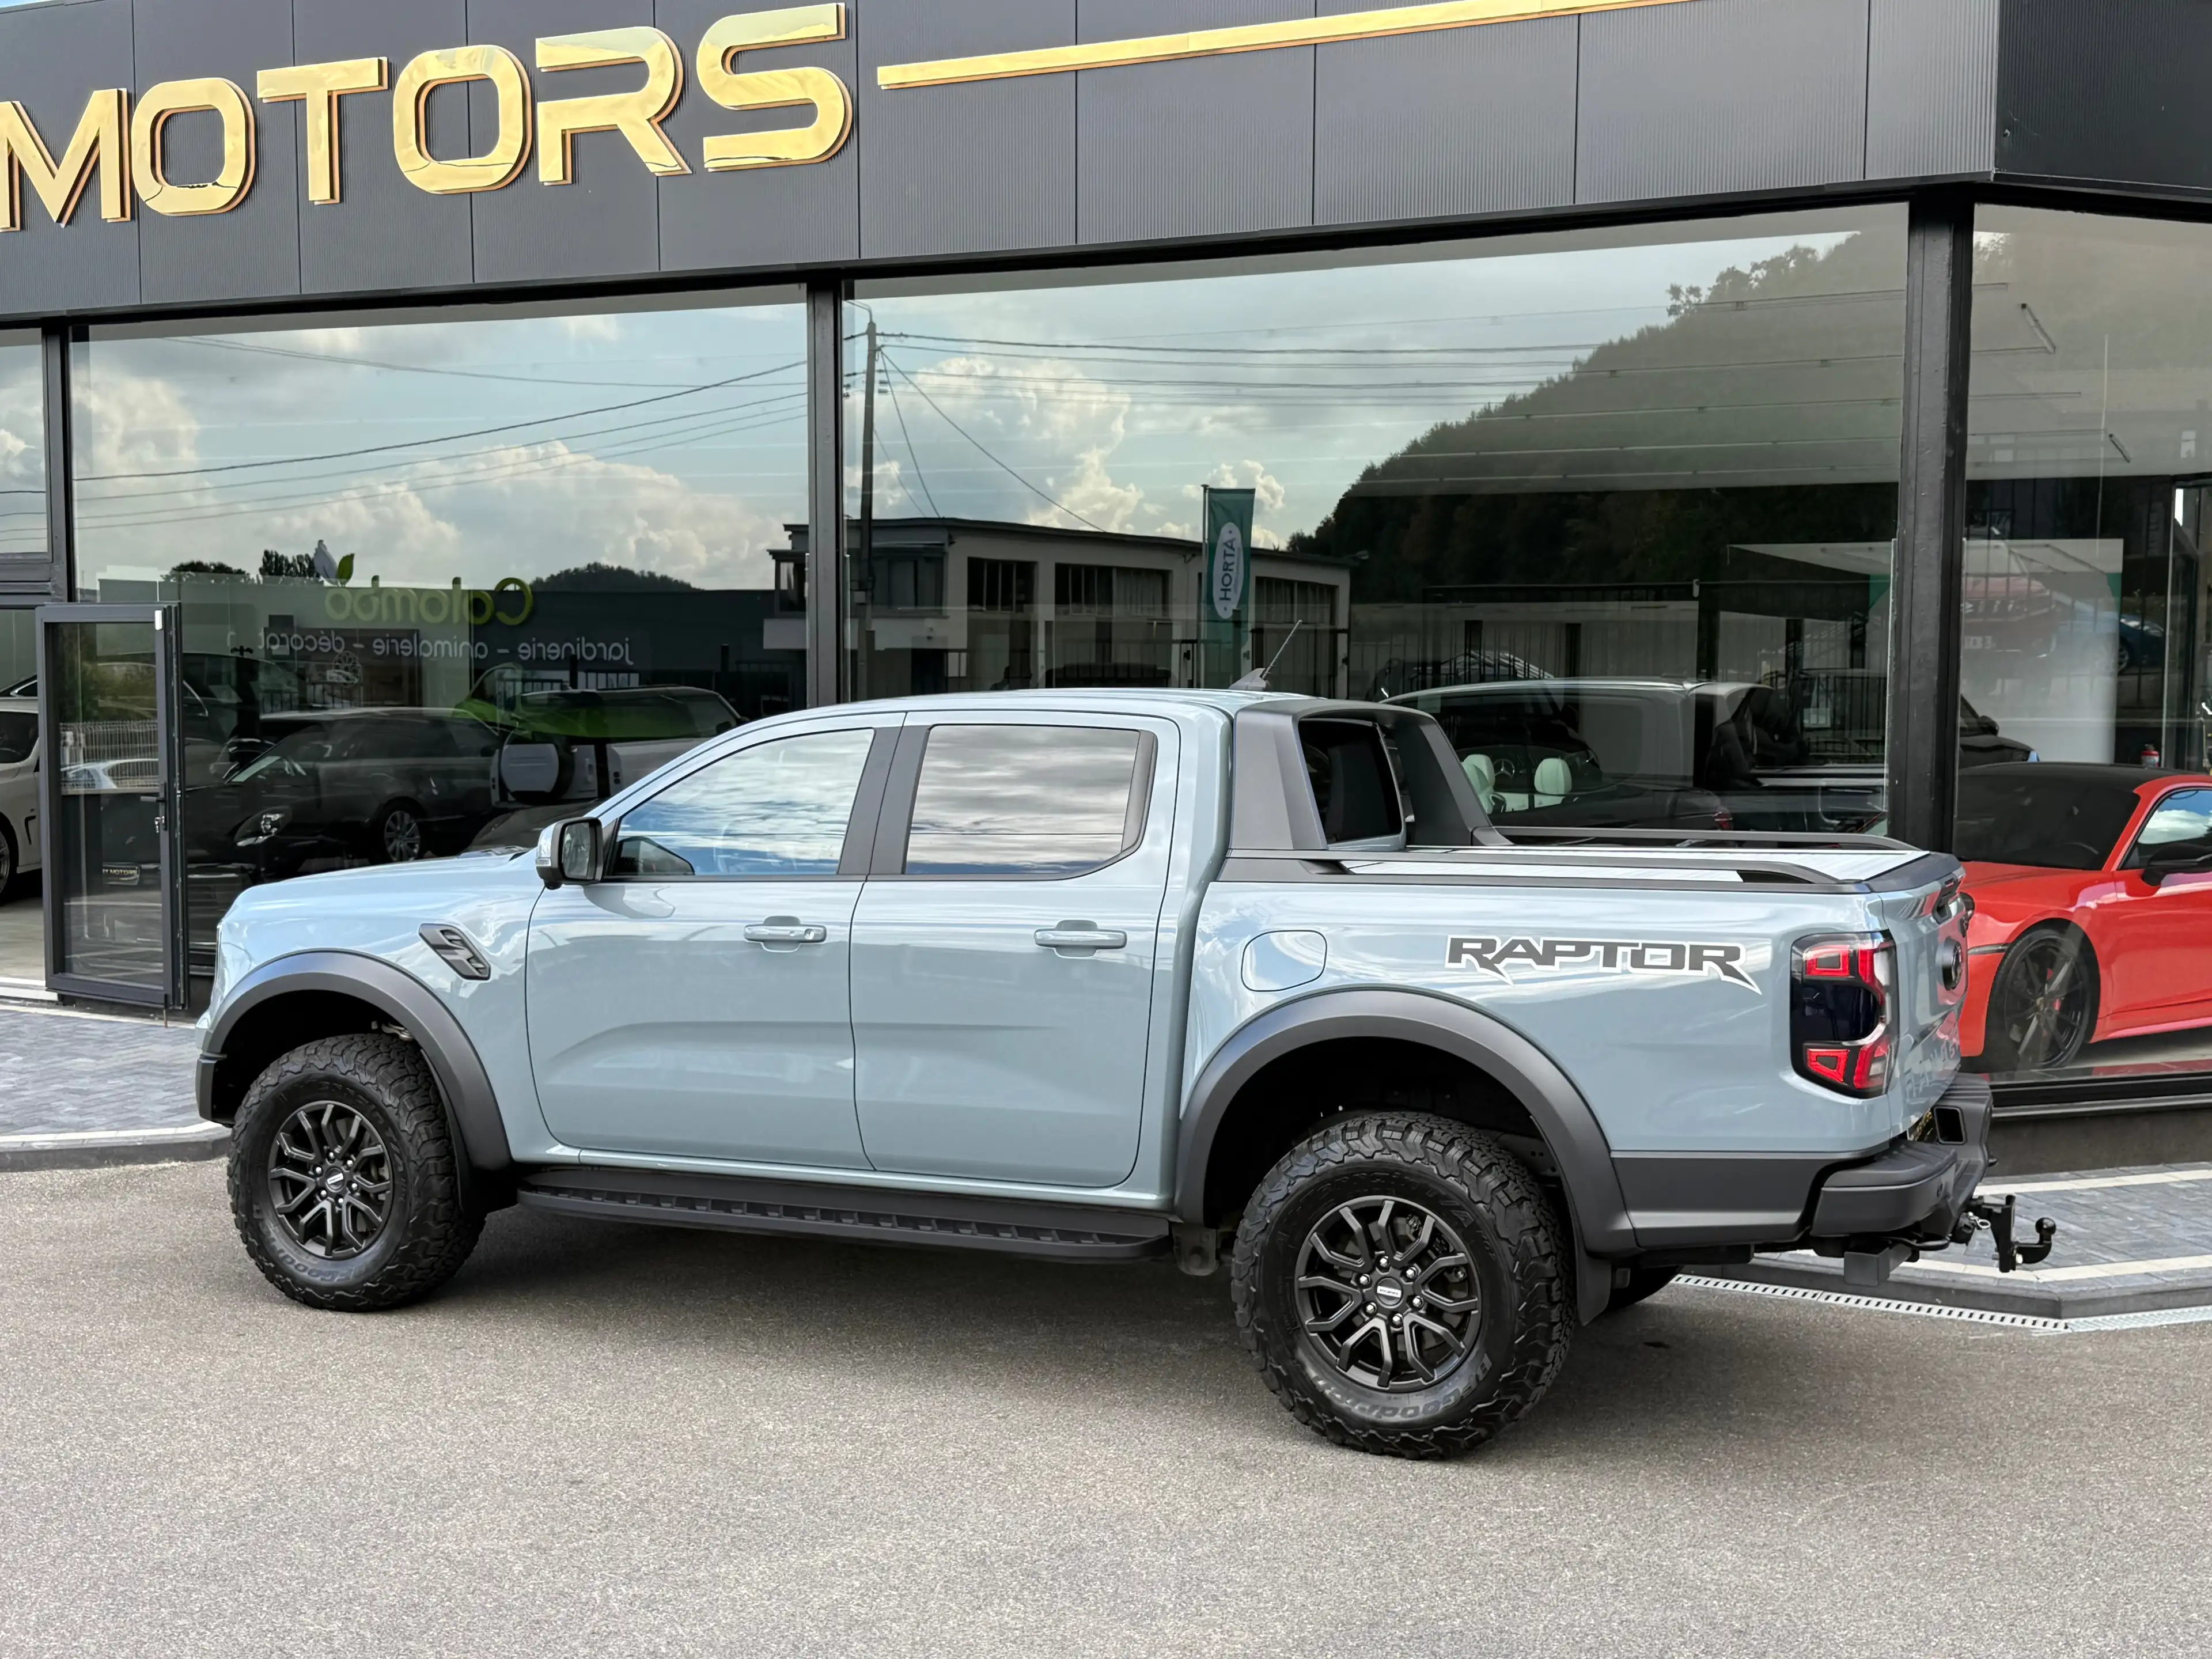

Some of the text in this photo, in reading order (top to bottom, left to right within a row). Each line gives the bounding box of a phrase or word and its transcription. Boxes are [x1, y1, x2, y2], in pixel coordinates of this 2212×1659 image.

[0, 2, 853, 232] MOTORS
[1219, 537, 1237, 601] HORTA
[1445, 935, 1763, 995] RAPTOR
